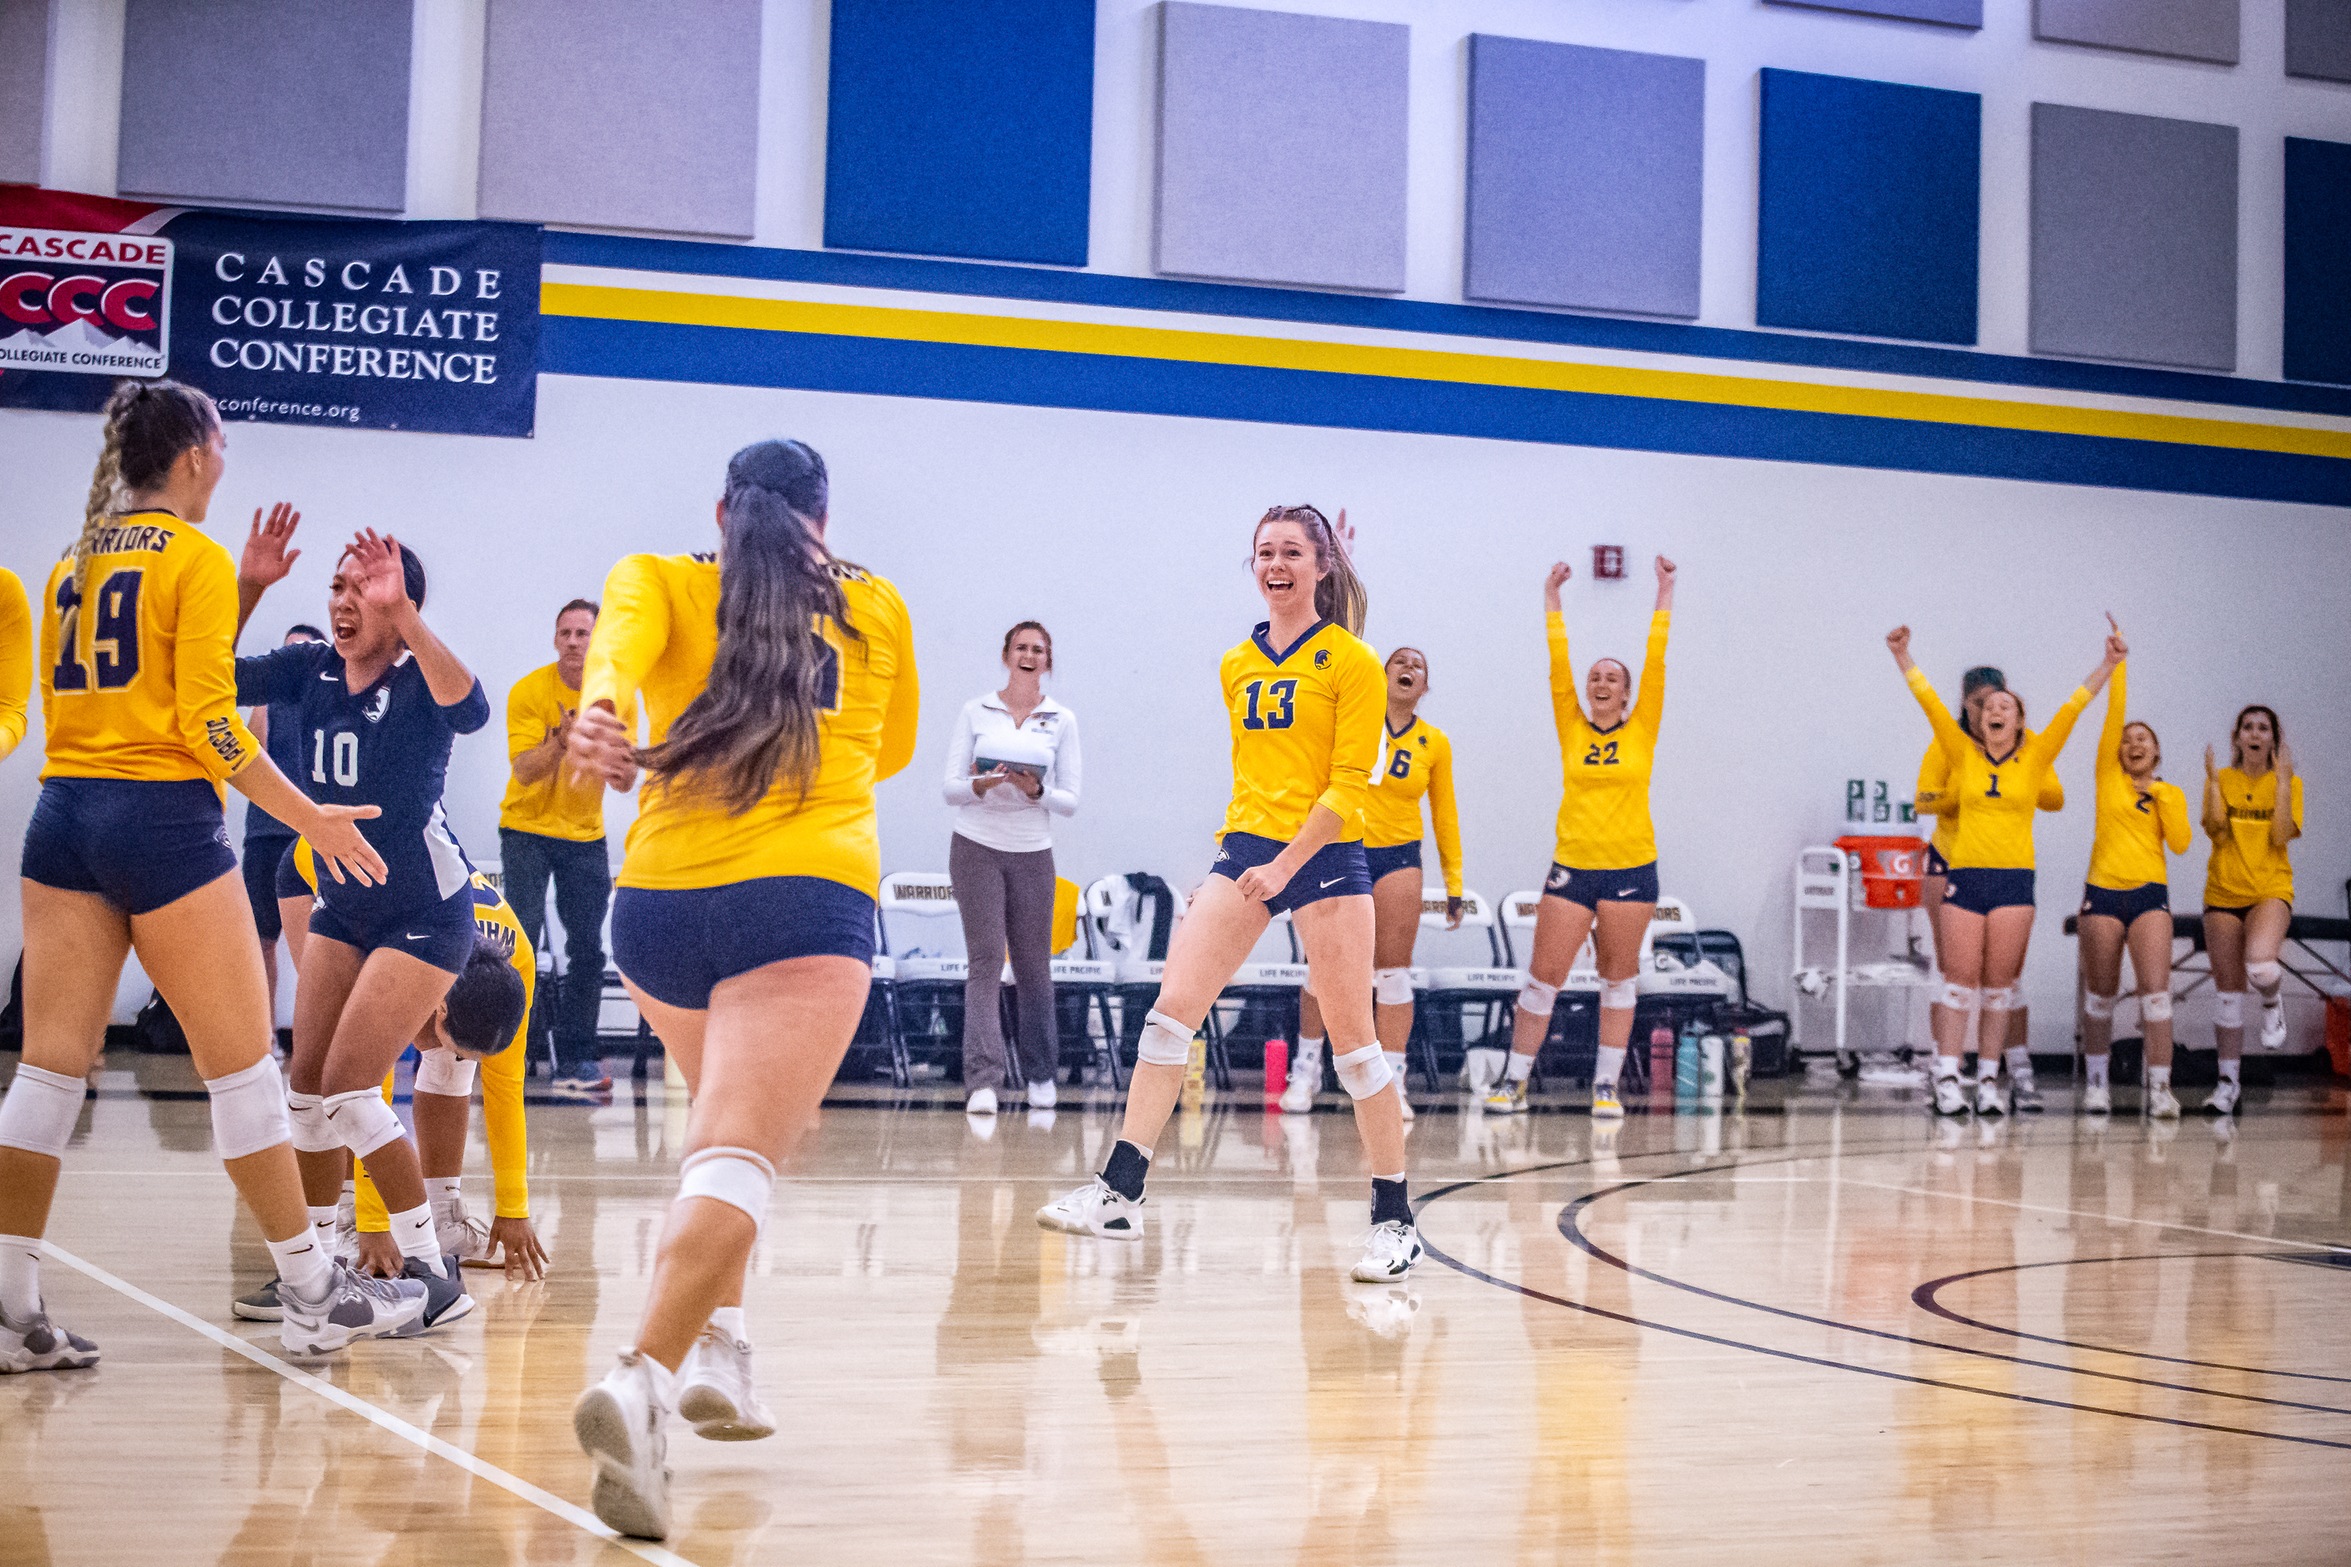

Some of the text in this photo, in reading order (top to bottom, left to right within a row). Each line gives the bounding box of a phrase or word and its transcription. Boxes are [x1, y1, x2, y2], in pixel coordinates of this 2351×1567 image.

[0, 234, 166, 265] CASCADE
[215, 252, 501, 299] CASCADE
[0, 271, 160, 331] CCC
[211, 295, 500, 342] COLLEGIATE
[72, 352, 161, 369] CONFERENCE
[209, 338, 497, 384] CONFERENCE
[213, 396, 361, 422] conference.org
[53, 566, 145, 696] 19
[1242, 679, 1299, 731] 13
[311, 728, 359, 787] 10
[1386, 742, 1412, 780] 6
[1583, 740, 1620, 766] 22
[1984, 773, 2001, 798] 1
[2134, 791, 2154, 815] 2
[941, 963, 960, 972] LIFE
[1260, 969, 1276, 977] LIFE
